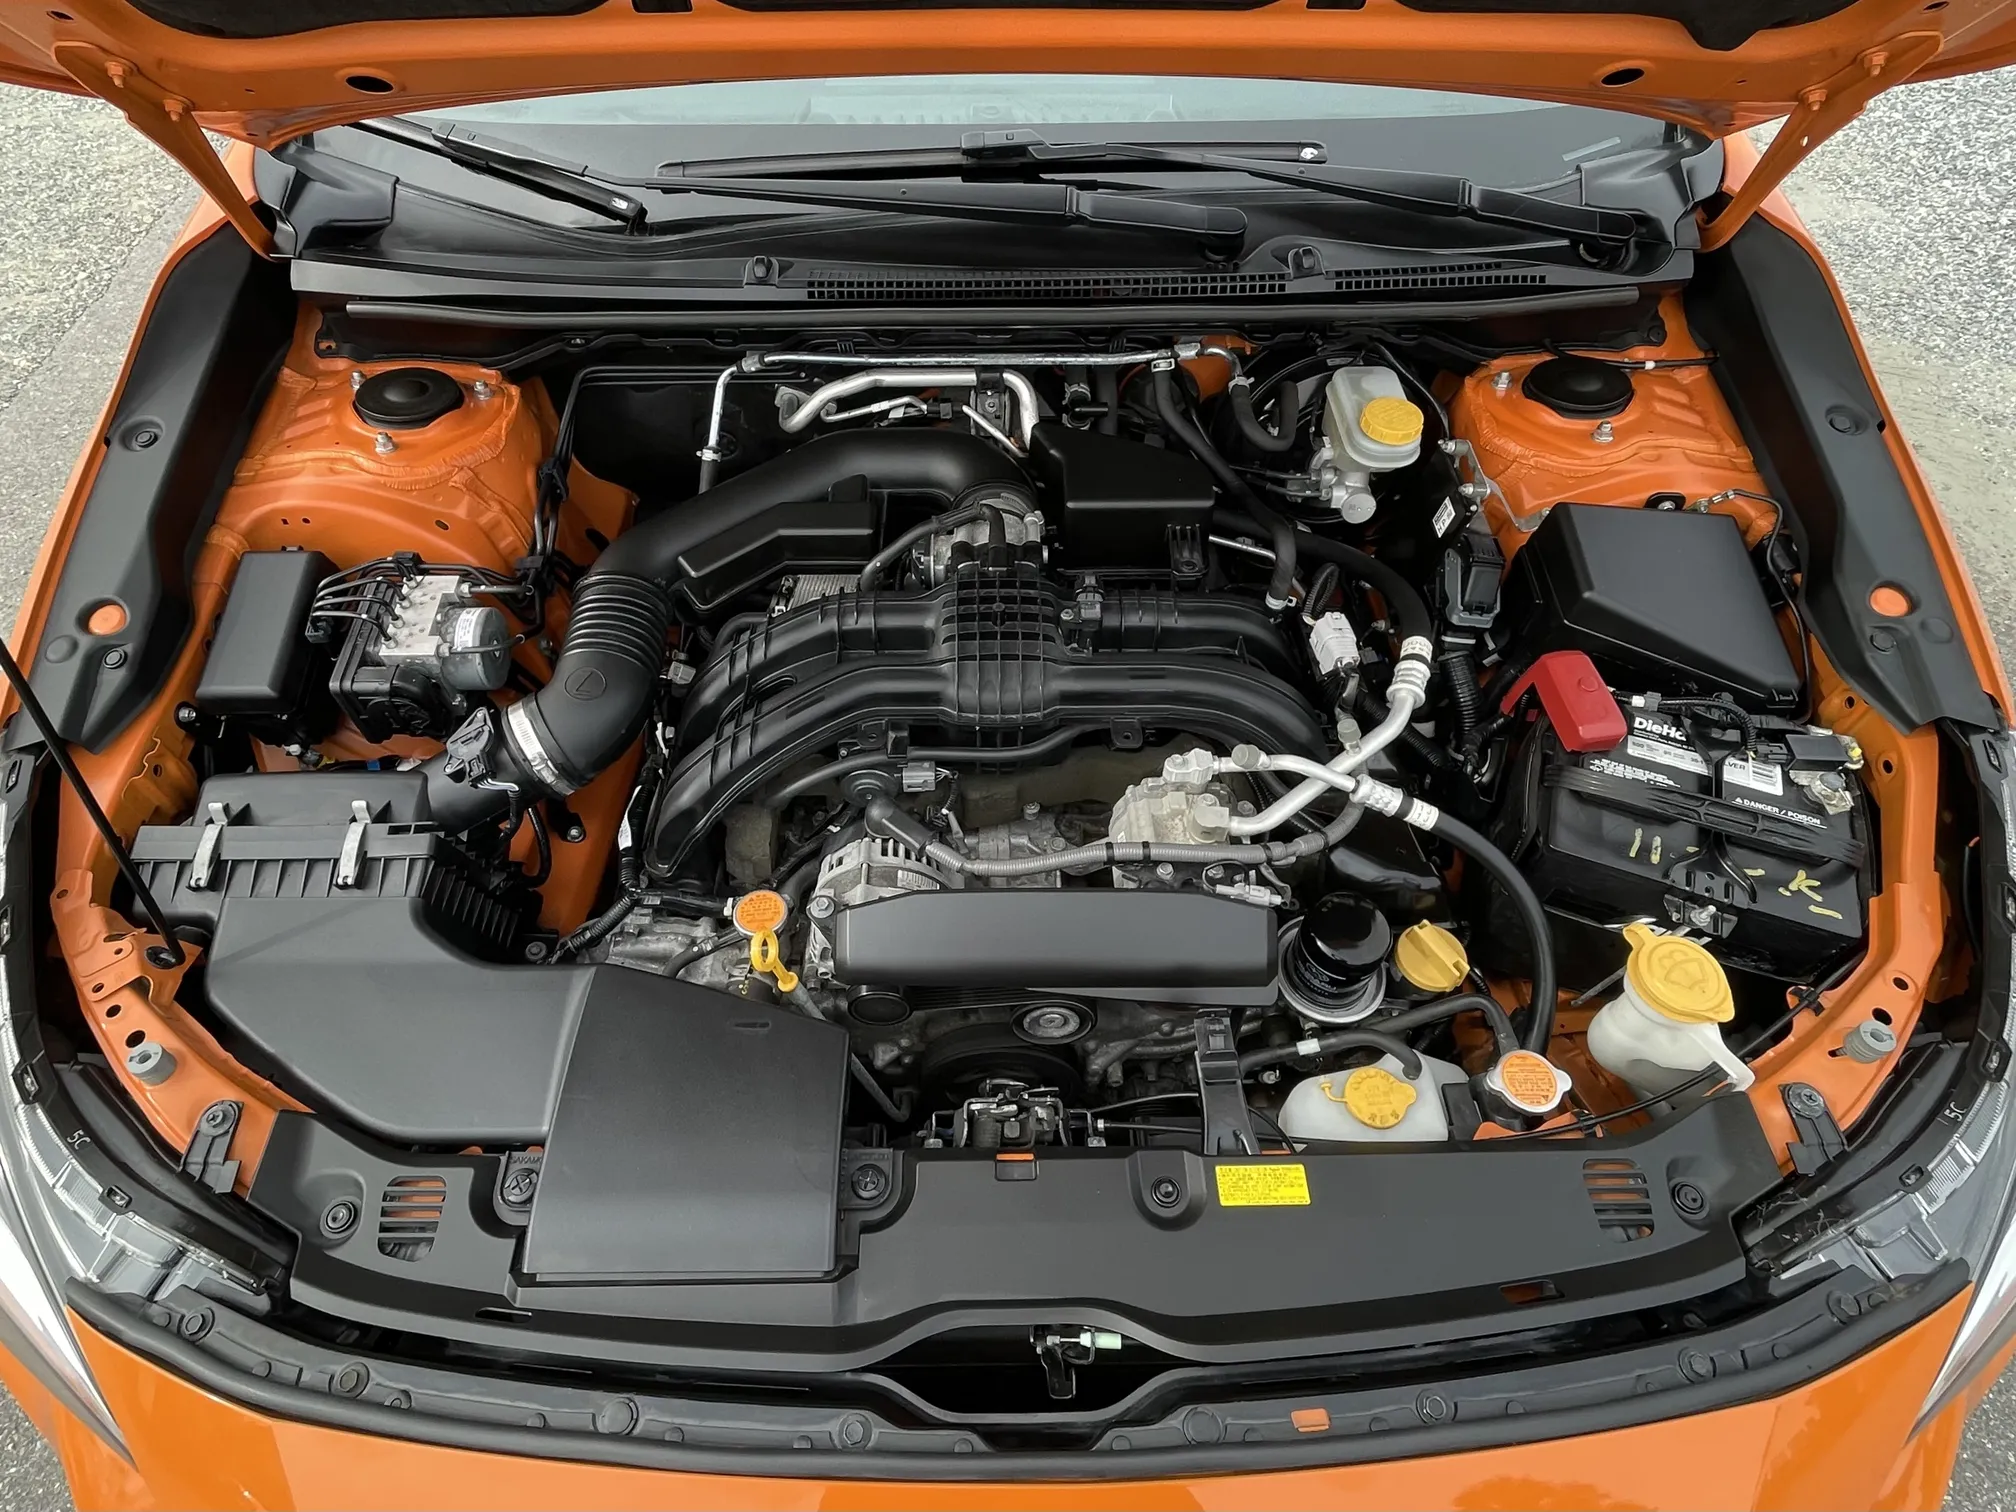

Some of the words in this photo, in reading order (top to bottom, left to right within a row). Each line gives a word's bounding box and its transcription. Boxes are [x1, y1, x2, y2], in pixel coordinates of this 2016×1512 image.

[1743, 798, 1779, 815] DANGER
[1787, 810, 1821, 825] POISON
[1943, 1101, 1968, 1122] 5C
[66, 1129, 91, 1150] 5C
